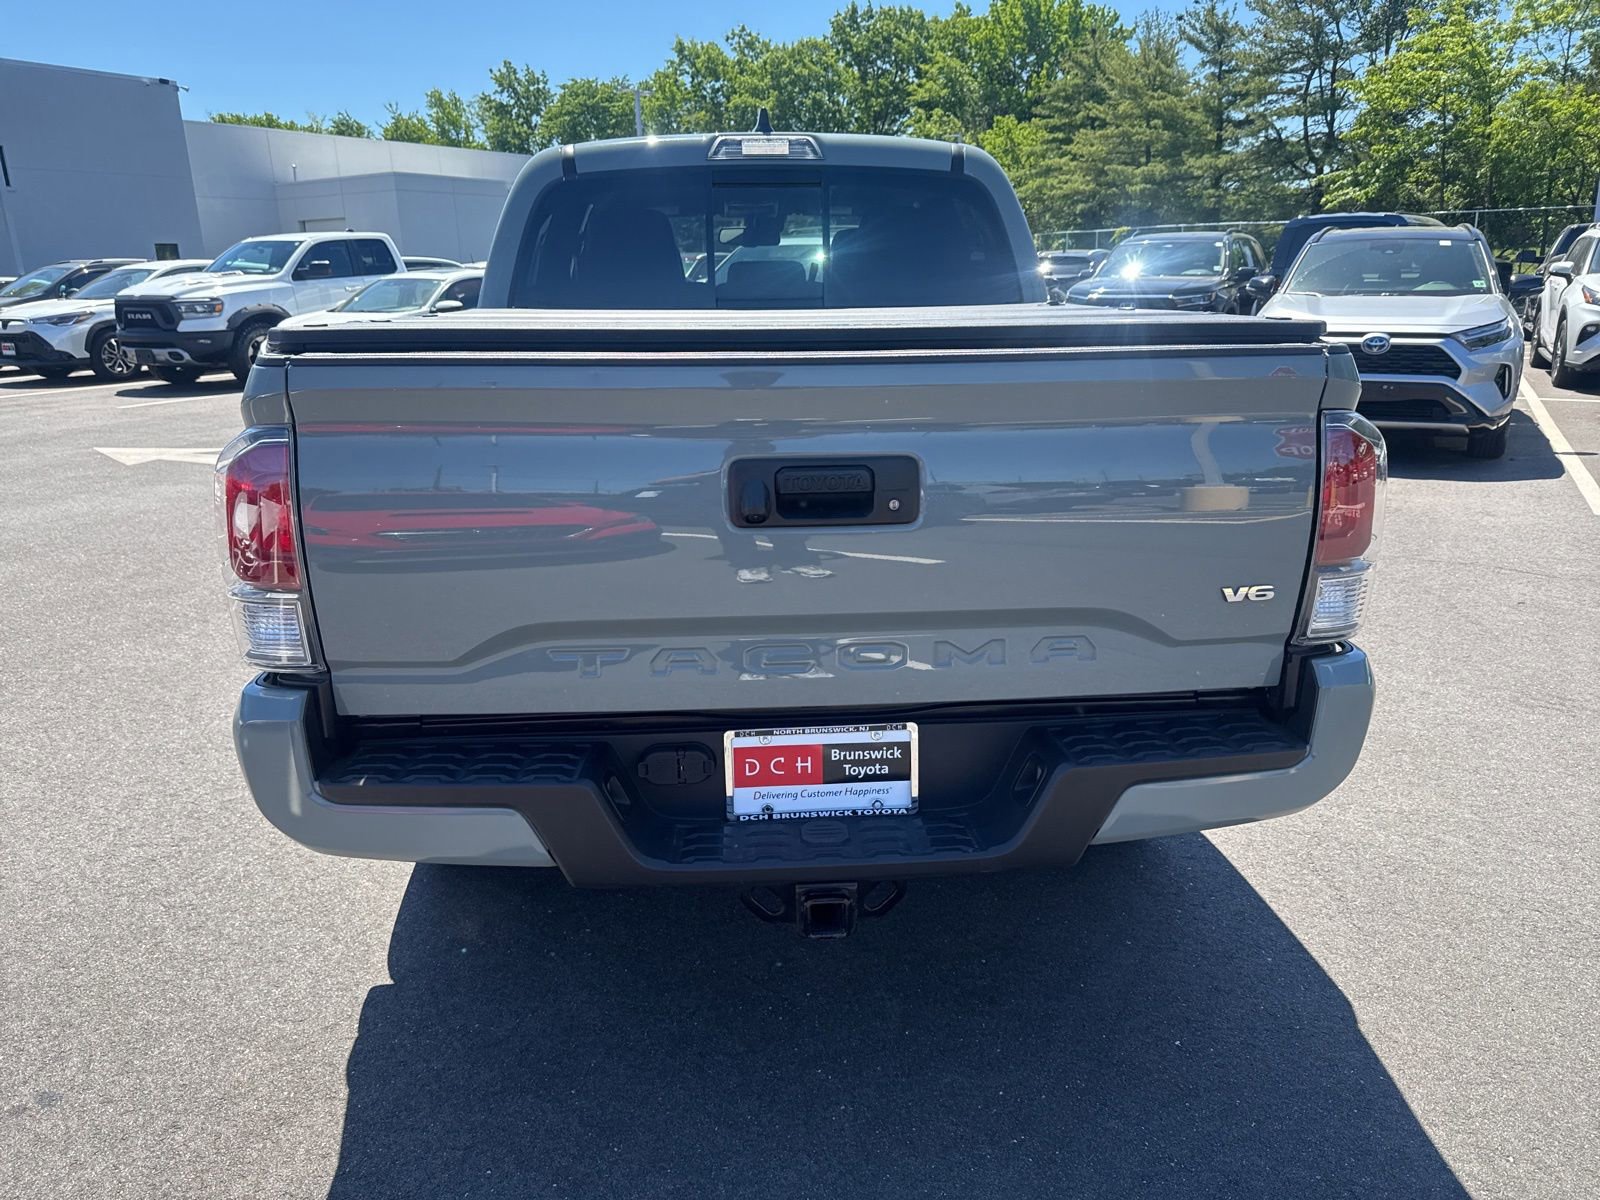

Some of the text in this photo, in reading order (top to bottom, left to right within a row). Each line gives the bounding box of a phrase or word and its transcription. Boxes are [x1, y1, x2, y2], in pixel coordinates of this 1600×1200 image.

[783, 473, 868, 490] TOYOTA
[1221, 585, 1275, 602] V6
[547, 635, 1097, 679] TACOMA
[773, 728, 803, 736] NORTH
[831, 746, 902, 760] Brunswick
[843, 764, 889, 778] Toyota
[753, 790, 799, 801] Delivering
[800, 789, 843, 798] Customer
[740, 808, 908, 821] DCH BRUNSWICK TOYOTA
